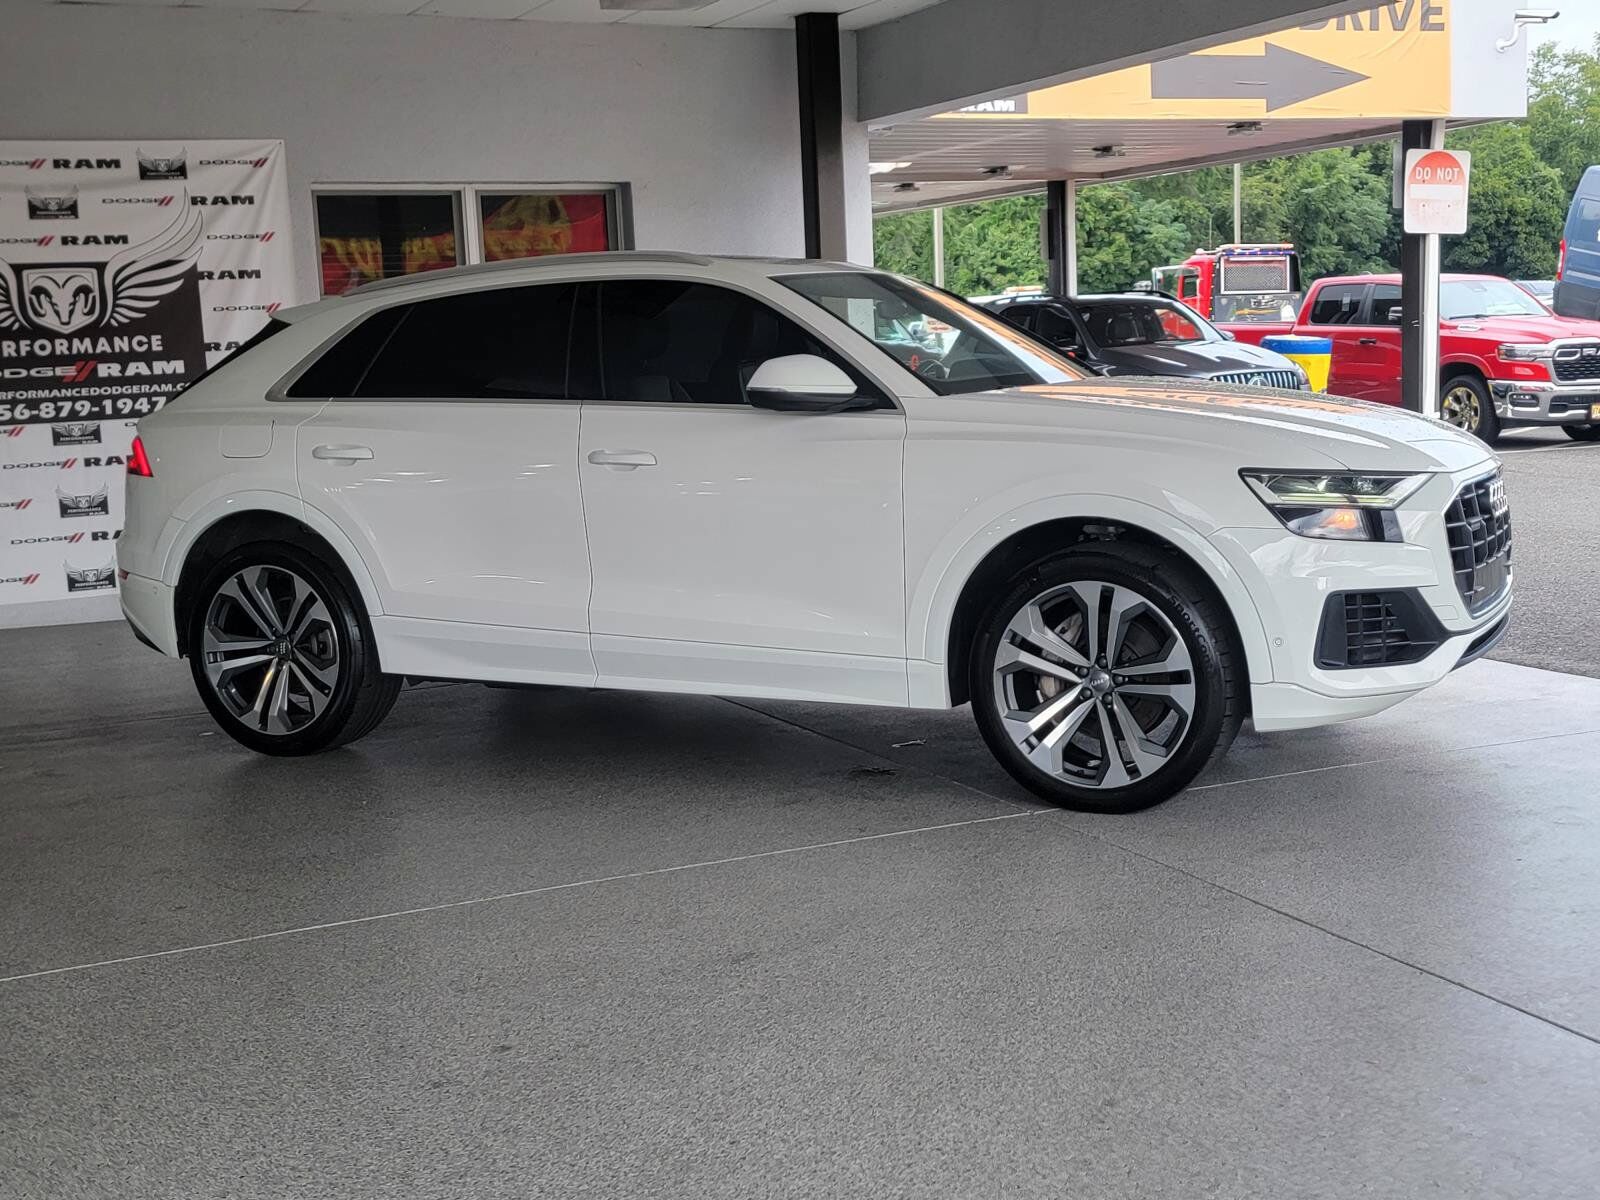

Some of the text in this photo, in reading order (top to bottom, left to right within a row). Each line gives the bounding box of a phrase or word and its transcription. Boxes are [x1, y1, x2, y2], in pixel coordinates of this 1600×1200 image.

[53, 158, 121, 169] RAM
[1415, 167, 1460, 180] DO NOT
[191, 195, 255, 206] RAM
[61, 235, 129, 246] RAM
[199, 269, 262, 280] RAM
[97, 359, 186, 378] RAM
